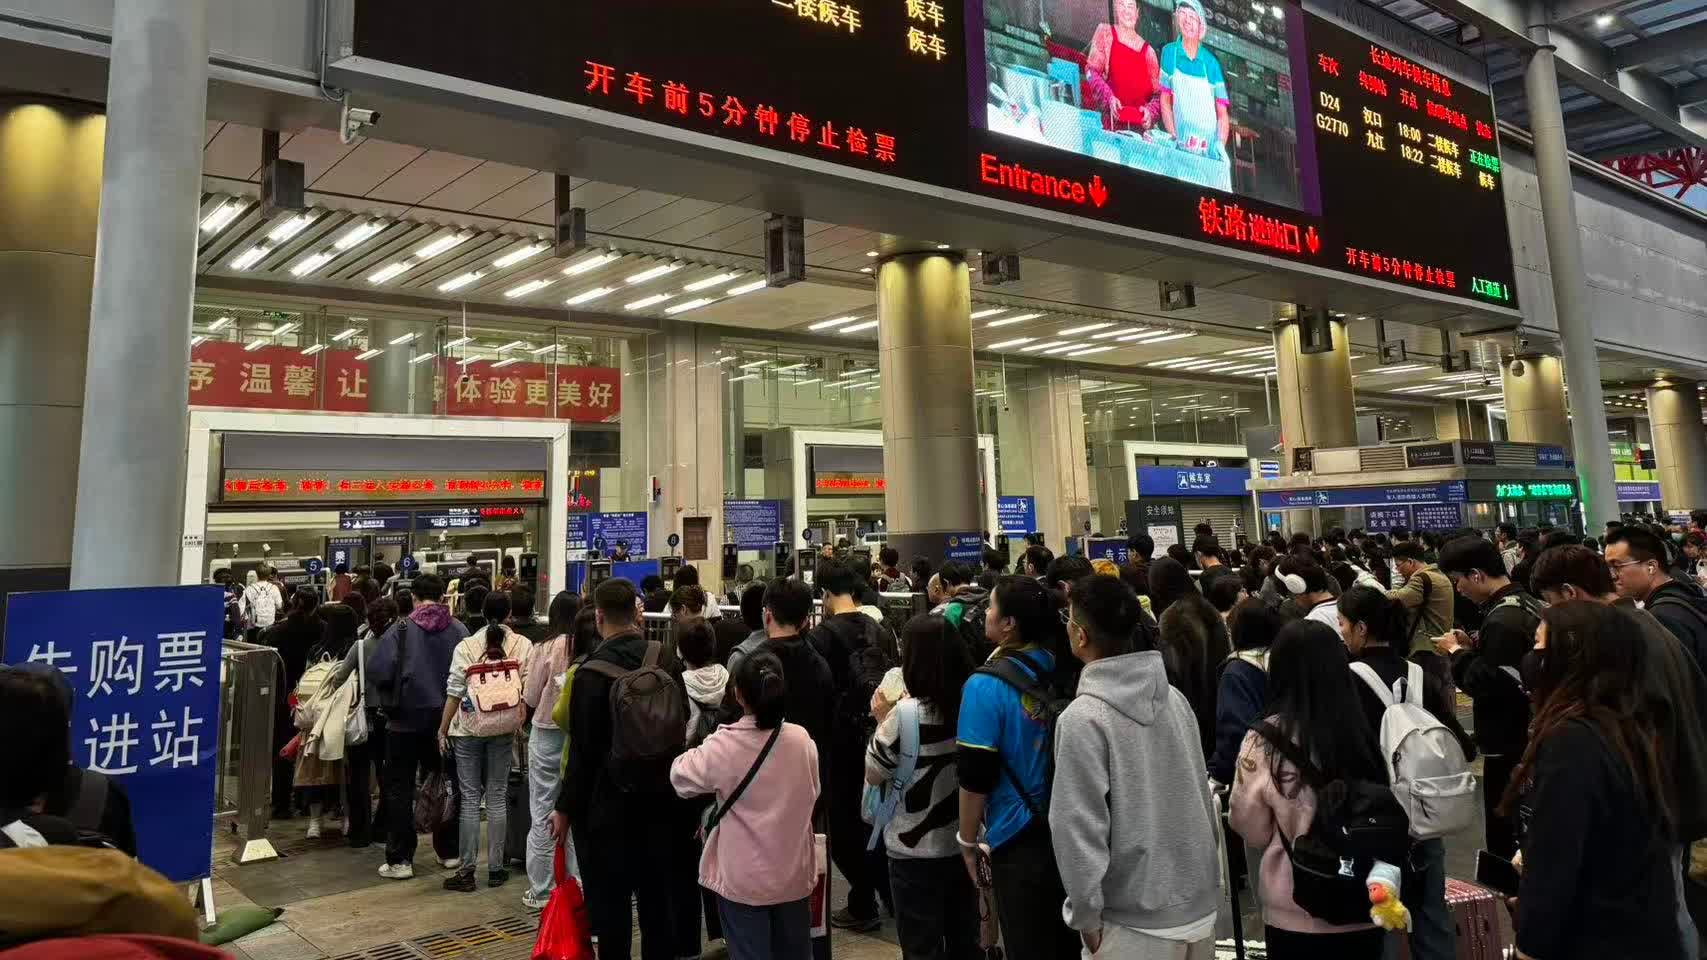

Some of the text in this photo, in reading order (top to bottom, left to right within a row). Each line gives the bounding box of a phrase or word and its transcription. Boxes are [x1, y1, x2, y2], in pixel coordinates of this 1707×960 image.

[905, 0, 945, 27] 候车
[907, 26, 947, 60] 候车
[584, 60, 896, 162] 开车前5分钟停止检票
[1320, 91, 1340, 111] D24
[1362, 107, 1382, 127] 汉口
[1398, 122, 1421, 142] 18:00
[1469, 149, 1500, 173] 正在检票
[1316, 113, 1349, 137] G2770
[1400, 144, 1424, 164] 18:22
[1478, 170, 1495, 190] 候车
[980, 152, 1085, 203] Entrance
[1199, 196, 1300, 252] 铁路进站口
[1188, 472, 1212, 484] 候车室
[310, 560, 317, 571] 5
[403, 557, 410, 567] 6
[68, 706, 203, 775] 进站
